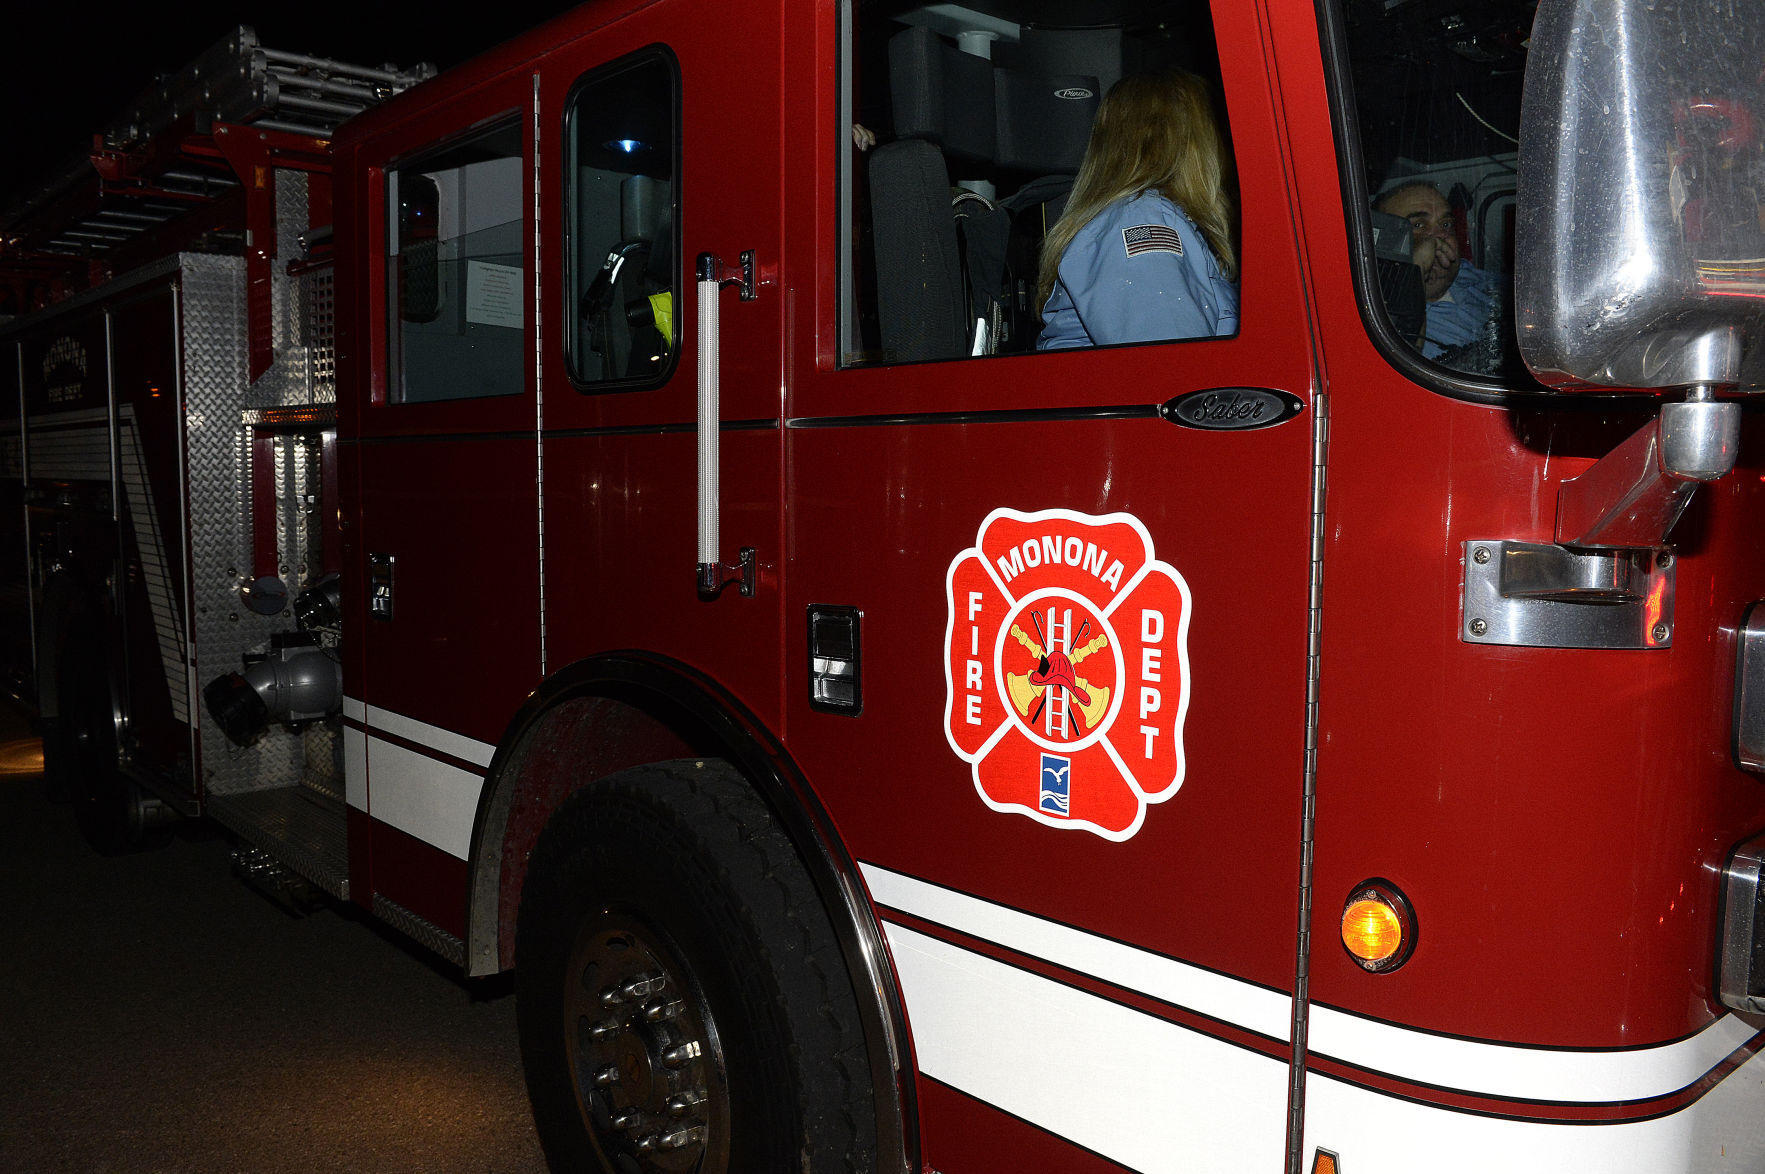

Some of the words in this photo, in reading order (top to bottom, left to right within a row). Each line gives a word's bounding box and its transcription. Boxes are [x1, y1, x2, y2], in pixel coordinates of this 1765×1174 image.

[1194, 391, 1264, 421] Saber
[997, 535, 1125, 593] MONONA
[966, 592, 983, 725] FIRE
[1140, 609, 1164, 759] DEPT
